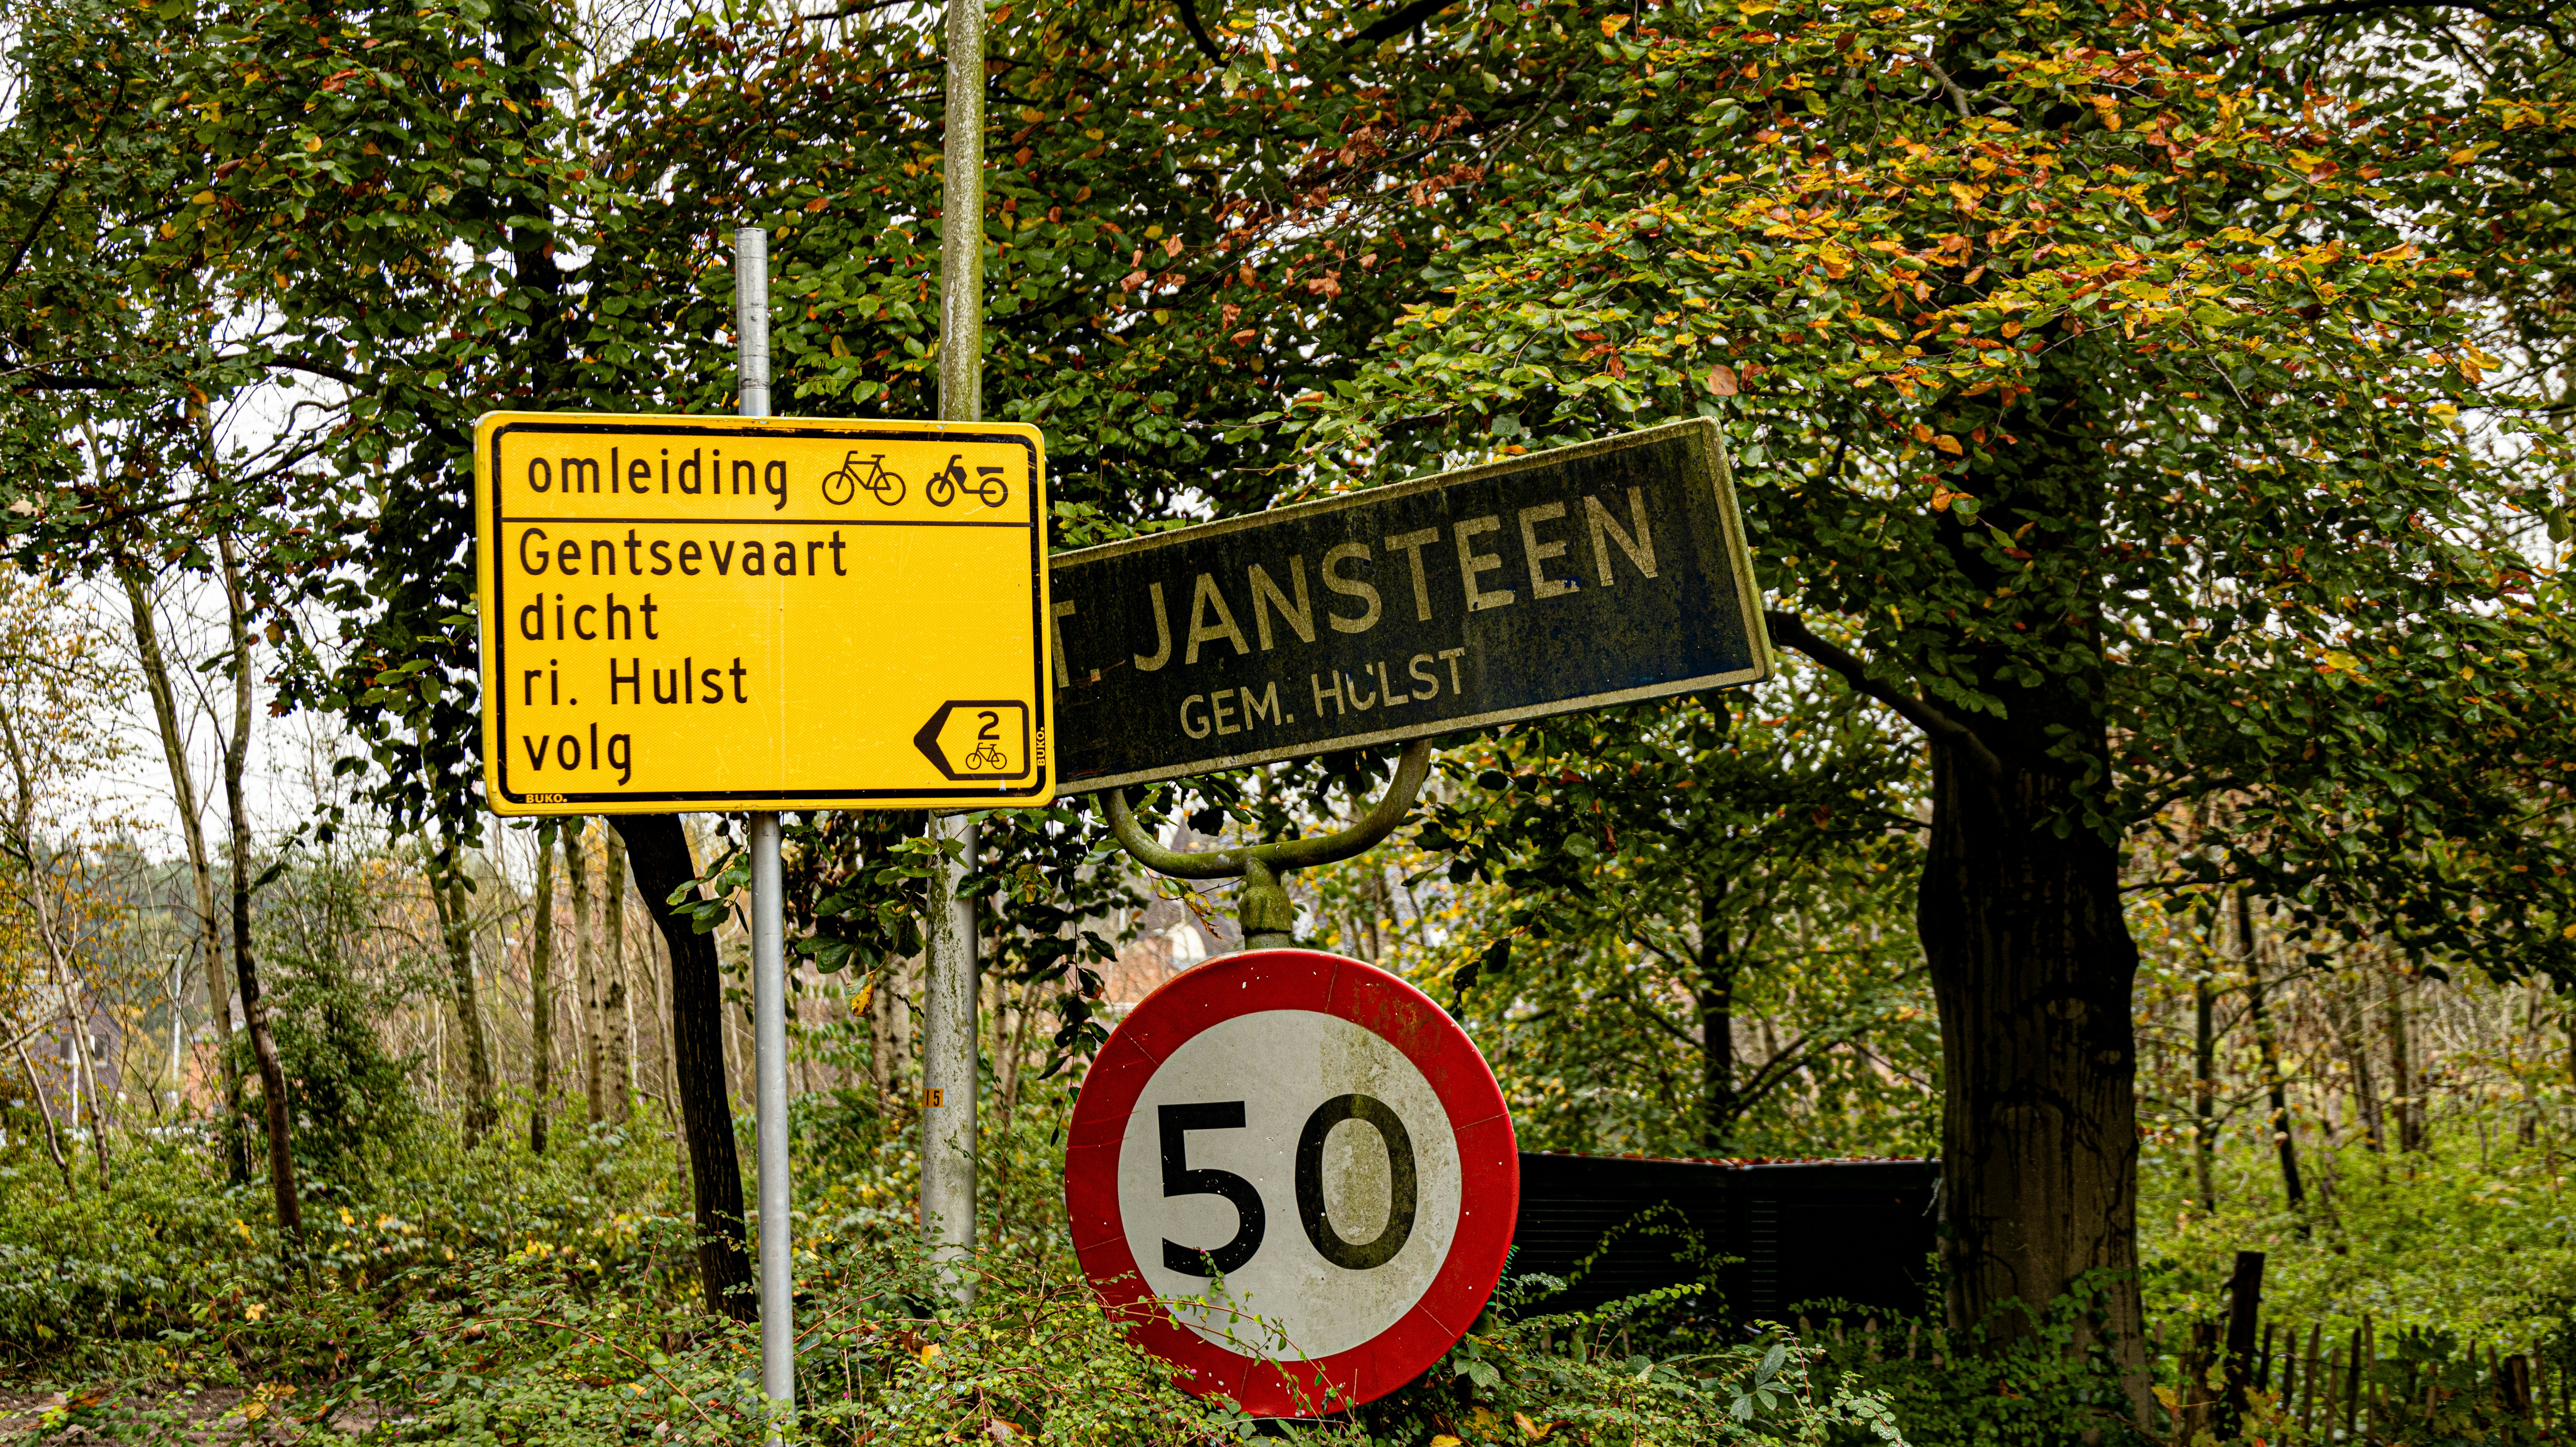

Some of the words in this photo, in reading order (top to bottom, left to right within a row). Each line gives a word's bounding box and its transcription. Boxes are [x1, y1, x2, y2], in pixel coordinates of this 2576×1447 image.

[529, 447, 787, 511] omleiding
[520, 528, 847, 576] Gentsevaart
[1134, 486, 1658, 671] JANSTEEN
[521, 593, 658, 640] dicht
[525, 659, 577, 705] ri.
[611, 657, 747, 704] Hulst
[1180, 681, 1294, 739] GEM.
[1311, 647, 1465, 718] HULST
[978, 711, 999, 740] 2
[1036, 727, 1046, 766] BUKO.
[523, 722, 631, 786] volg
[526, 794, 567, 803] BUKO.
[926, 1089, 940, 1106] 15
[1157, 1093, 1418, 1277] 50
